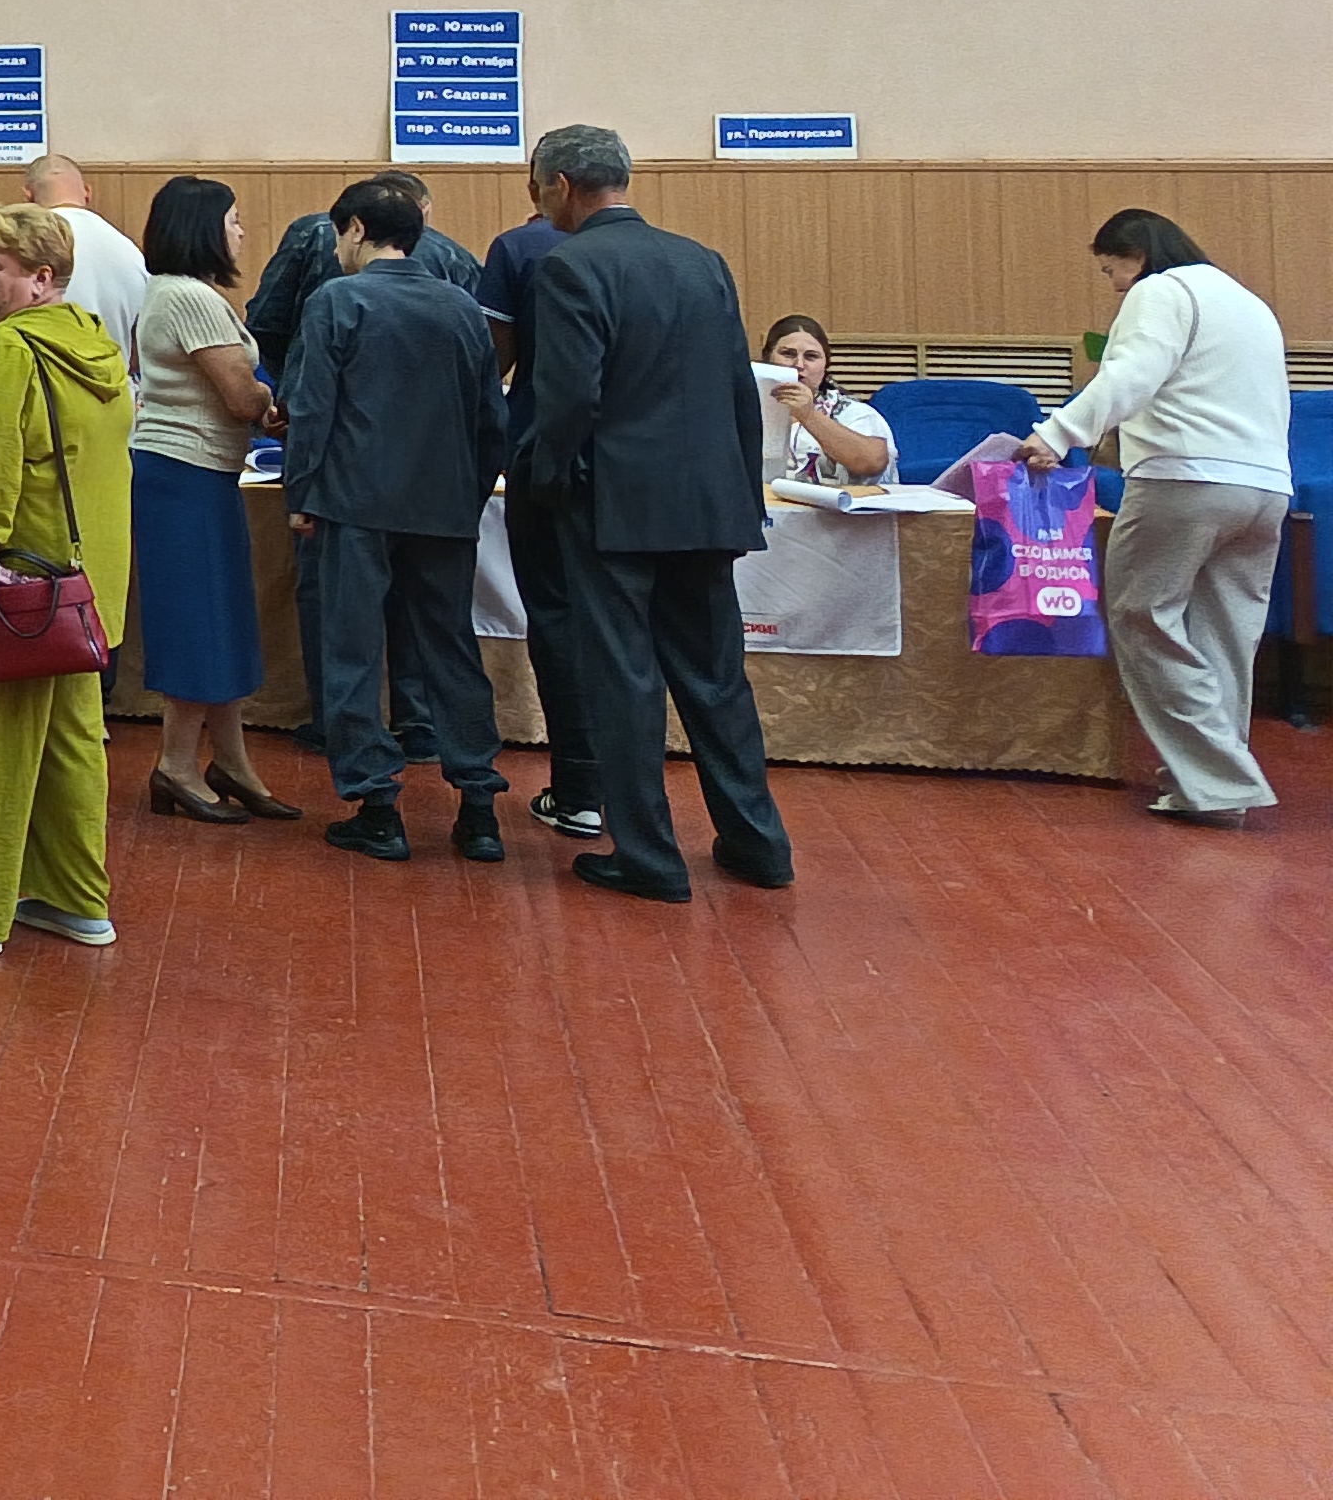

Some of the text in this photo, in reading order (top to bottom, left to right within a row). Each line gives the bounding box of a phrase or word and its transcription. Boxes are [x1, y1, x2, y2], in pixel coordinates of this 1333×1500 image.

[409, 20, 505, 33] пер. Южный
[399, 57, 417, 68] ул.
[419, 55, 435, 66] 70
[461, 55, 514, 68] Октября
[416, 88, 507, 101] ул. Садовая
[406, 122, 512, 135] пер. Садовый
